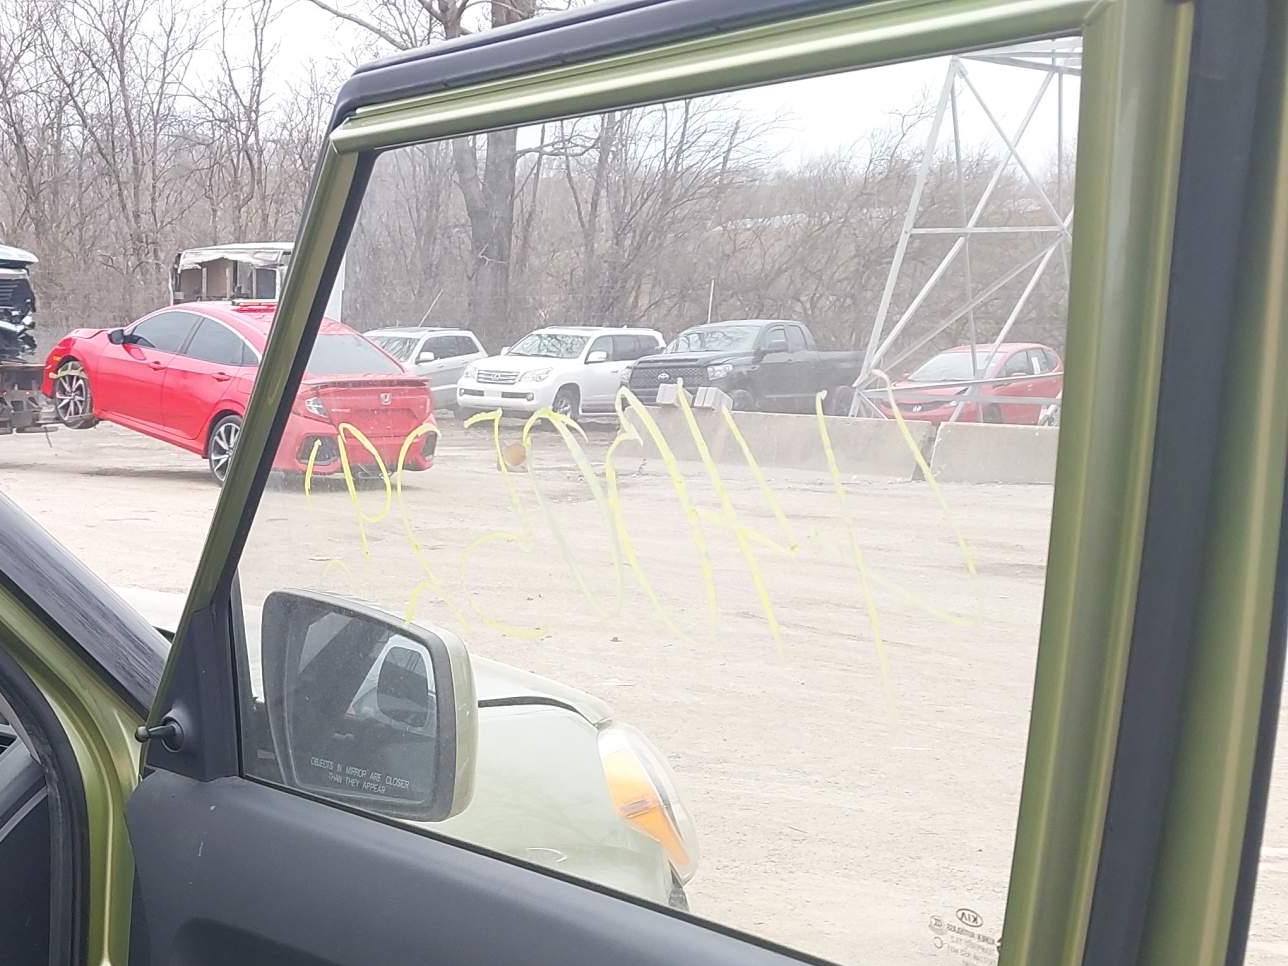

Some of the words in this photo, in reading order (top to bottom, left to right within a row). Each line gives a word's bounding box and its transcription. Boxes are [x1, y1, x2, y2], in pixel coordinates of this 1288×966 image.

[310, 756, 334, 770] OBJECTS
[345, 765, 367, 778] MIRROR
[369, 770, 382, 782] ARE
[385, 775, 410, 790] CLOSER
[328, 772, 343, 785] THAN
[345, 776, 361, 788] THEY
[361, 780, 386, 794] APPEAR
